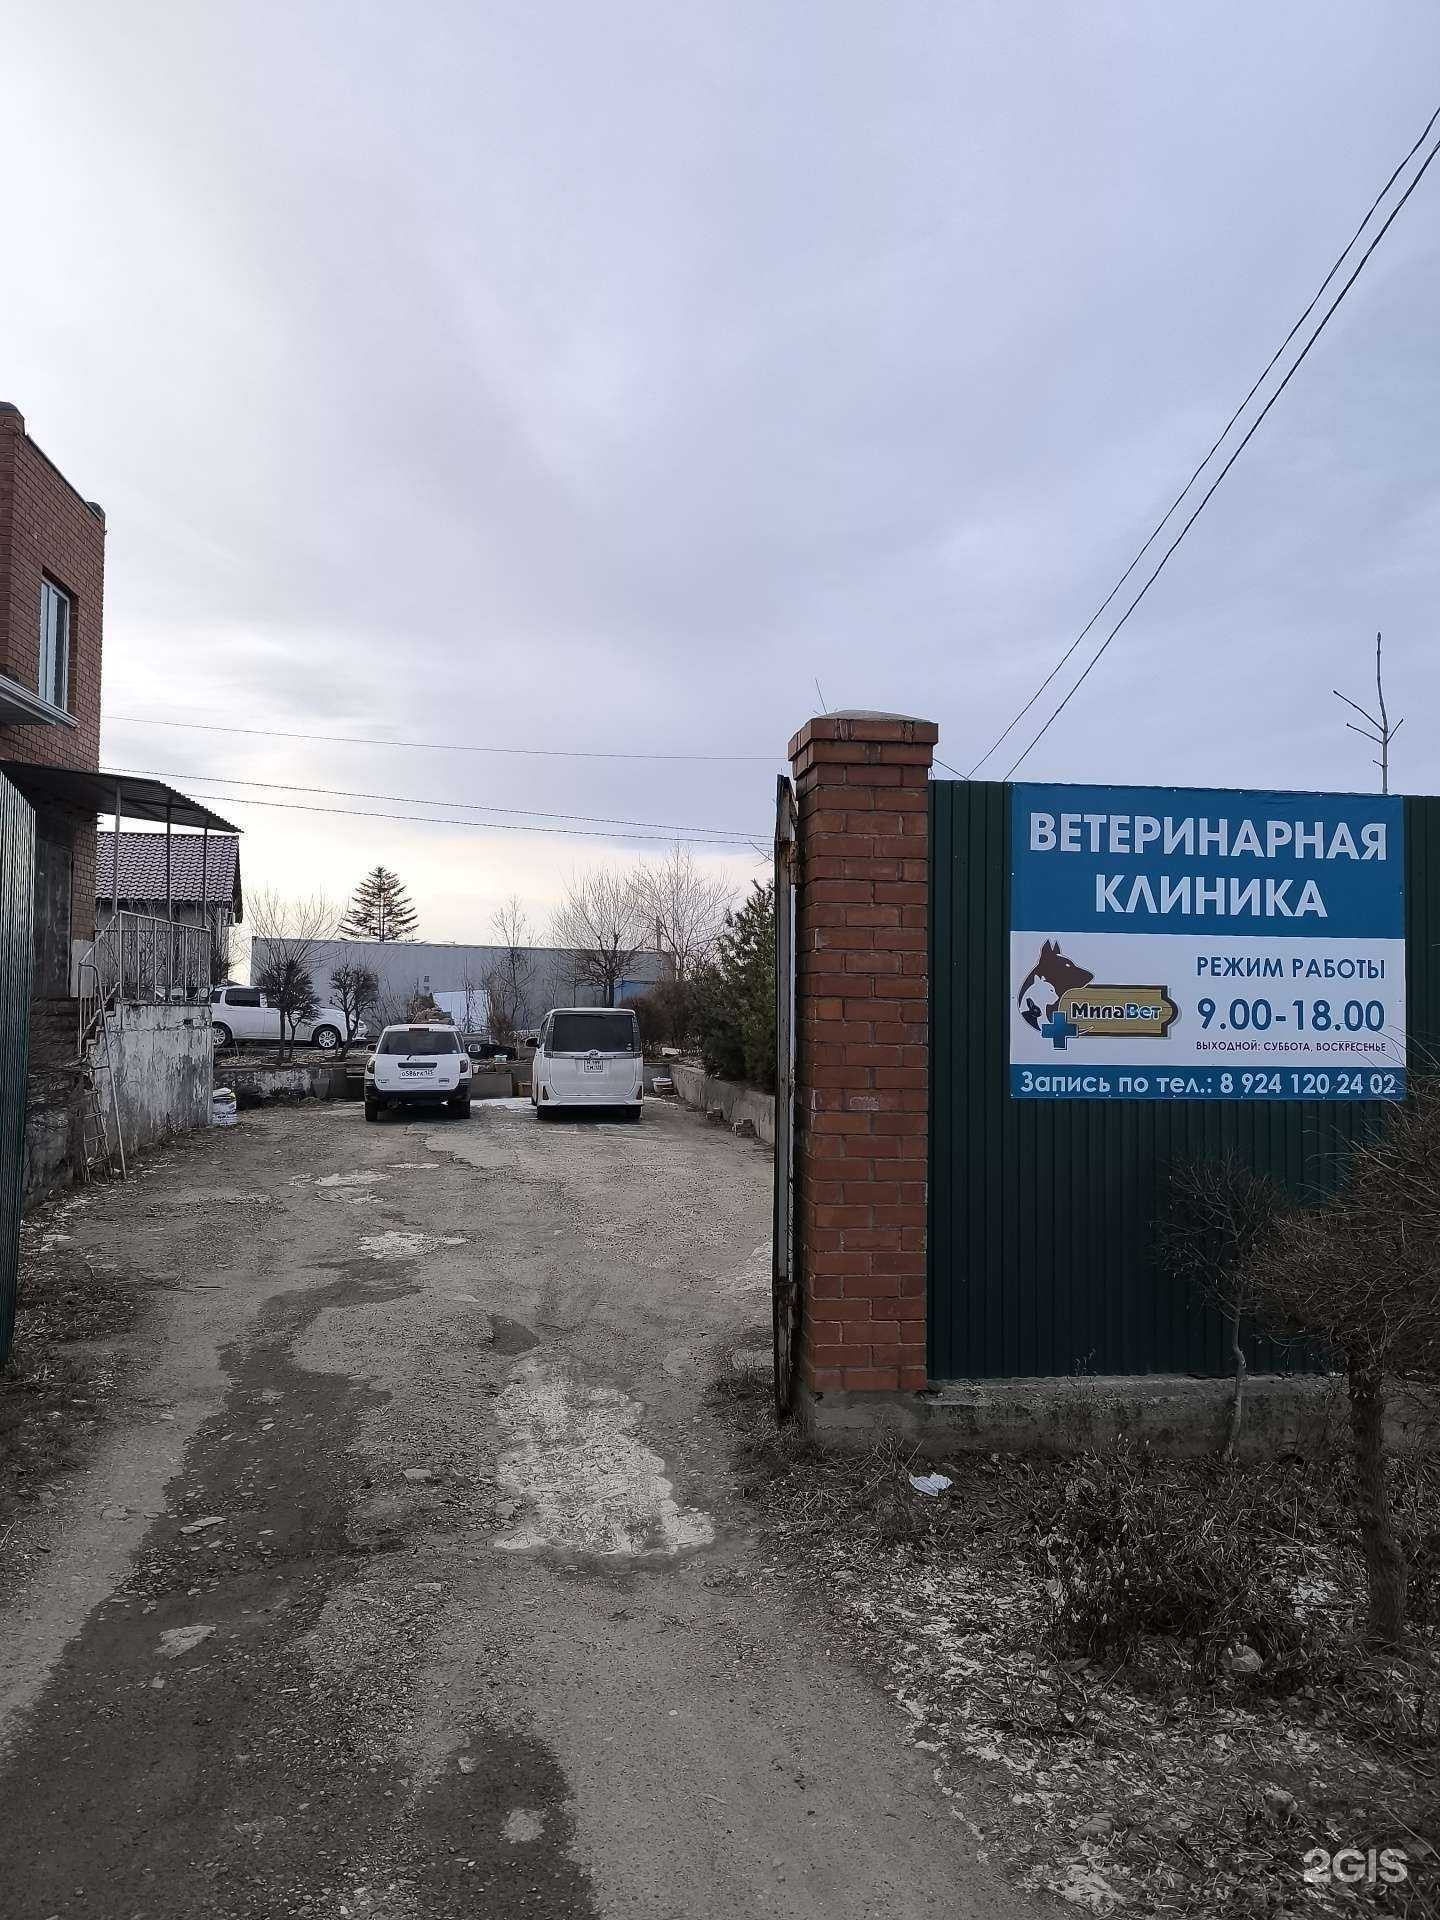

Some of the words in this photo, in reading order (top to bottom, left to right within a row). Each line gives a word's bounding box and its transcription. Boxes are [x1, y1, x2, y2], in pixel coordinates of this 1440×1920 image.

[1029, 812, 1387, 861] ВЕТЕРИНАРНАЯ
[1095, 874, 1328, 918] КЛИНИКА
[1197, 957, 1284, 978] РЕЖИМ
[1292, 958, 1385, 979] РАБОТЫ
[1071, 1002, 1161, 1021] МилаВет
[1197, 998, 1385, 1032] 9.00-18.00
[1196, 1040, 1261, 1051] ВЫХОДНОЙ:
[1263, 1042, 1313, 1052] СУББОТА,
[1316, 1042, 1386, 1052] ВОСКРЕСЕНЬЕ
[1020, 1071, 1111, 1093] Запись
[1119, 1077, 1149, 1093] по
[1156, 1077, 1212, 1094] тел.:
[1220, 1073, 1234, 1094] 8
[1241, 1073, 1282, 1094] 924
[1291, 1074, 1330, 1094] 120
[1336, 1074, 1363, 1094] 24
[1369, 1074, 1396, 1095] 02
